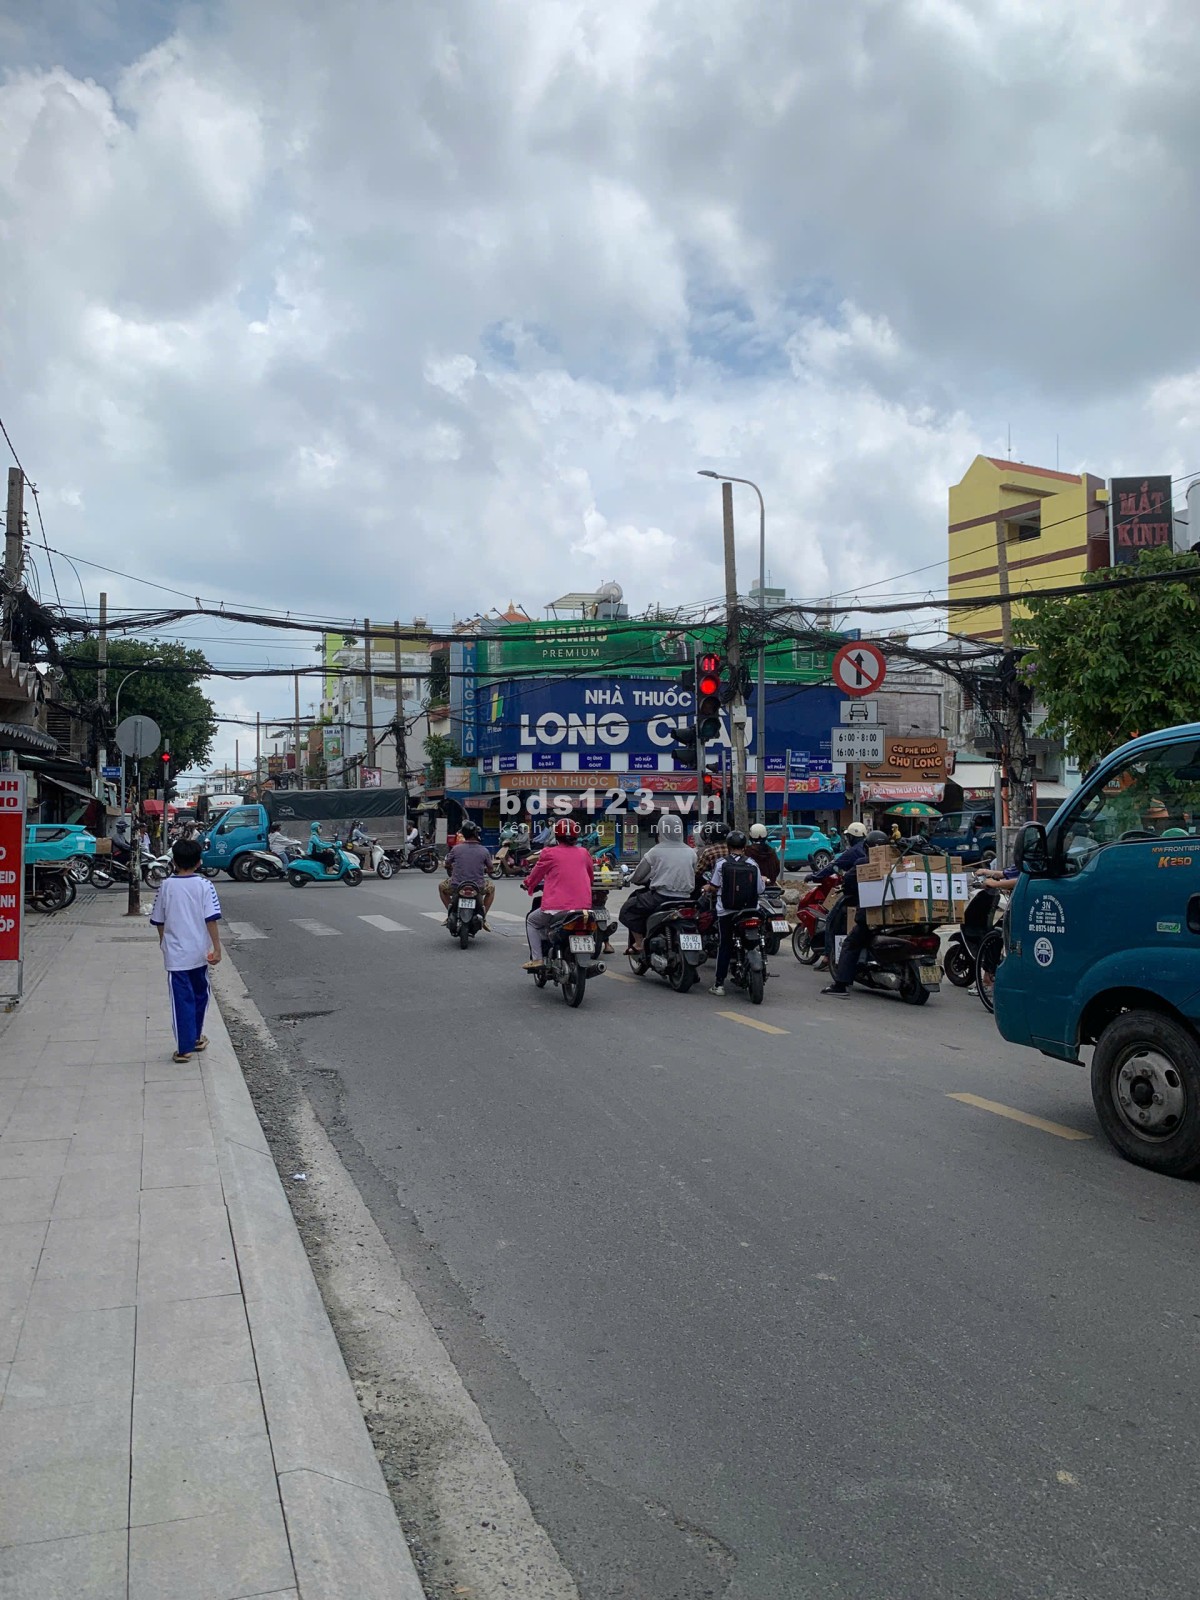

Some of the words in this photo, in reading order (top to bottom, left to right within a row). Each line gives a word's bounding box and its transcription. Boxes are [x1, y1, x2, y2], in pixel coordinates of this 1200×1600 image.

[1119, 481, 1163, 515] MẮT
[1117, 517, 1169, 546] KÍNH
[542, 648, 600, 658] PREMIUM
[585, 685, 624, 705] NHÀ
[633, 685, 692, 706] THUỐC
[520, 712, 630, 746] LONG
[839, 733, 855, 742] 6:00
[861, 733, 877, 742] 8:00
[914, 756, 942, 768] LONG
[511, 774, 557, 786] CHUYÊN
[562, 772, 609, 786] THUỐC
[1158, 856, 1192, 868] K250
